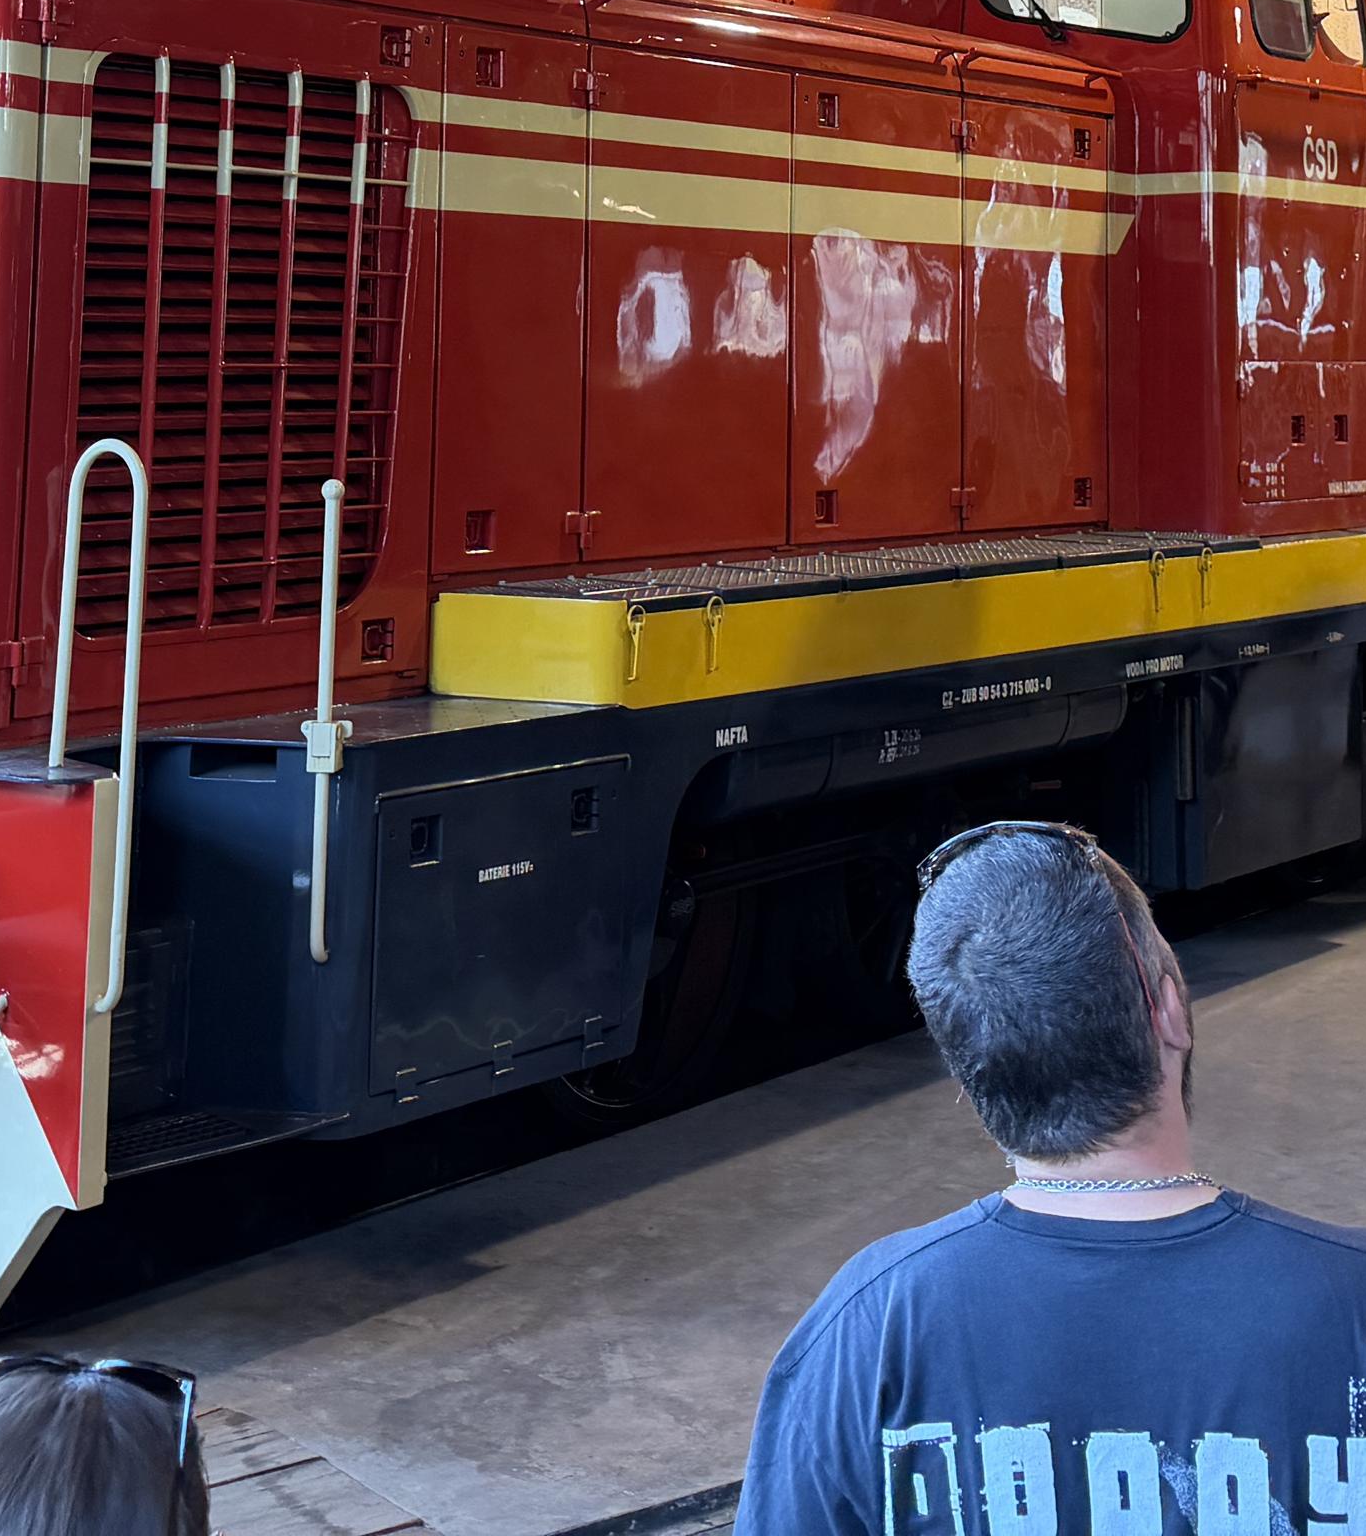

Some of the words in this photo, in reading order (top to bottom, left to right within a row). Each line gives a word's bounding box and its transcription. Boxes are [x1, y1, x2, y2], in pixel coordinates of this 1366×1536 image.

[1303, 124, 1338, 181] ČSD
[715, 725, 749, 748] NAFTA
[478, 864, 511, 883] BATERIE
